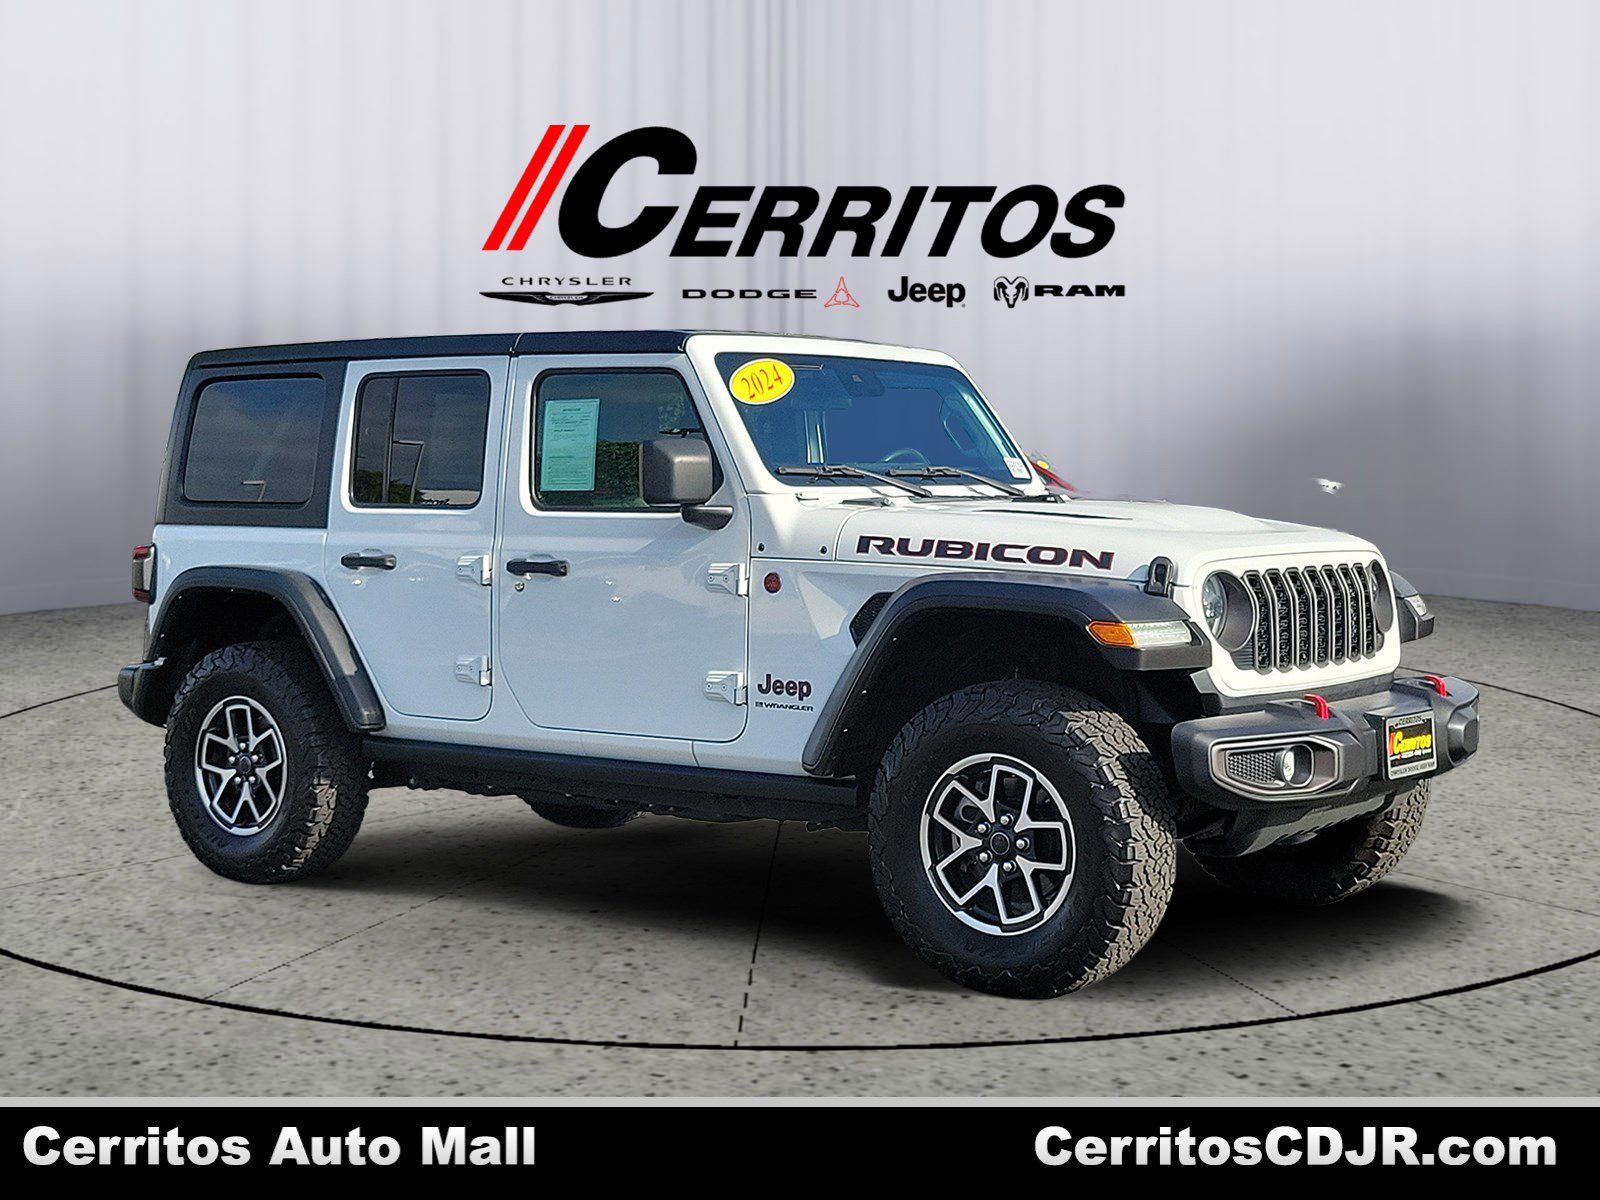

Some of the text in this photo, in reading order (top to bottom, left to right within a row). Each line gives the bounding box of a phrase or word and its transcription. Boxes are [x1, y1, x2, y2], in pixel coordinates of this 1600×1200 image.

[741, 364, 783, 399] 2024
[856, 535, 1115, 570] RUBICON
[757, 674, 812, 701] Jeep
[764, 702, 814, 711] WRANGLER
